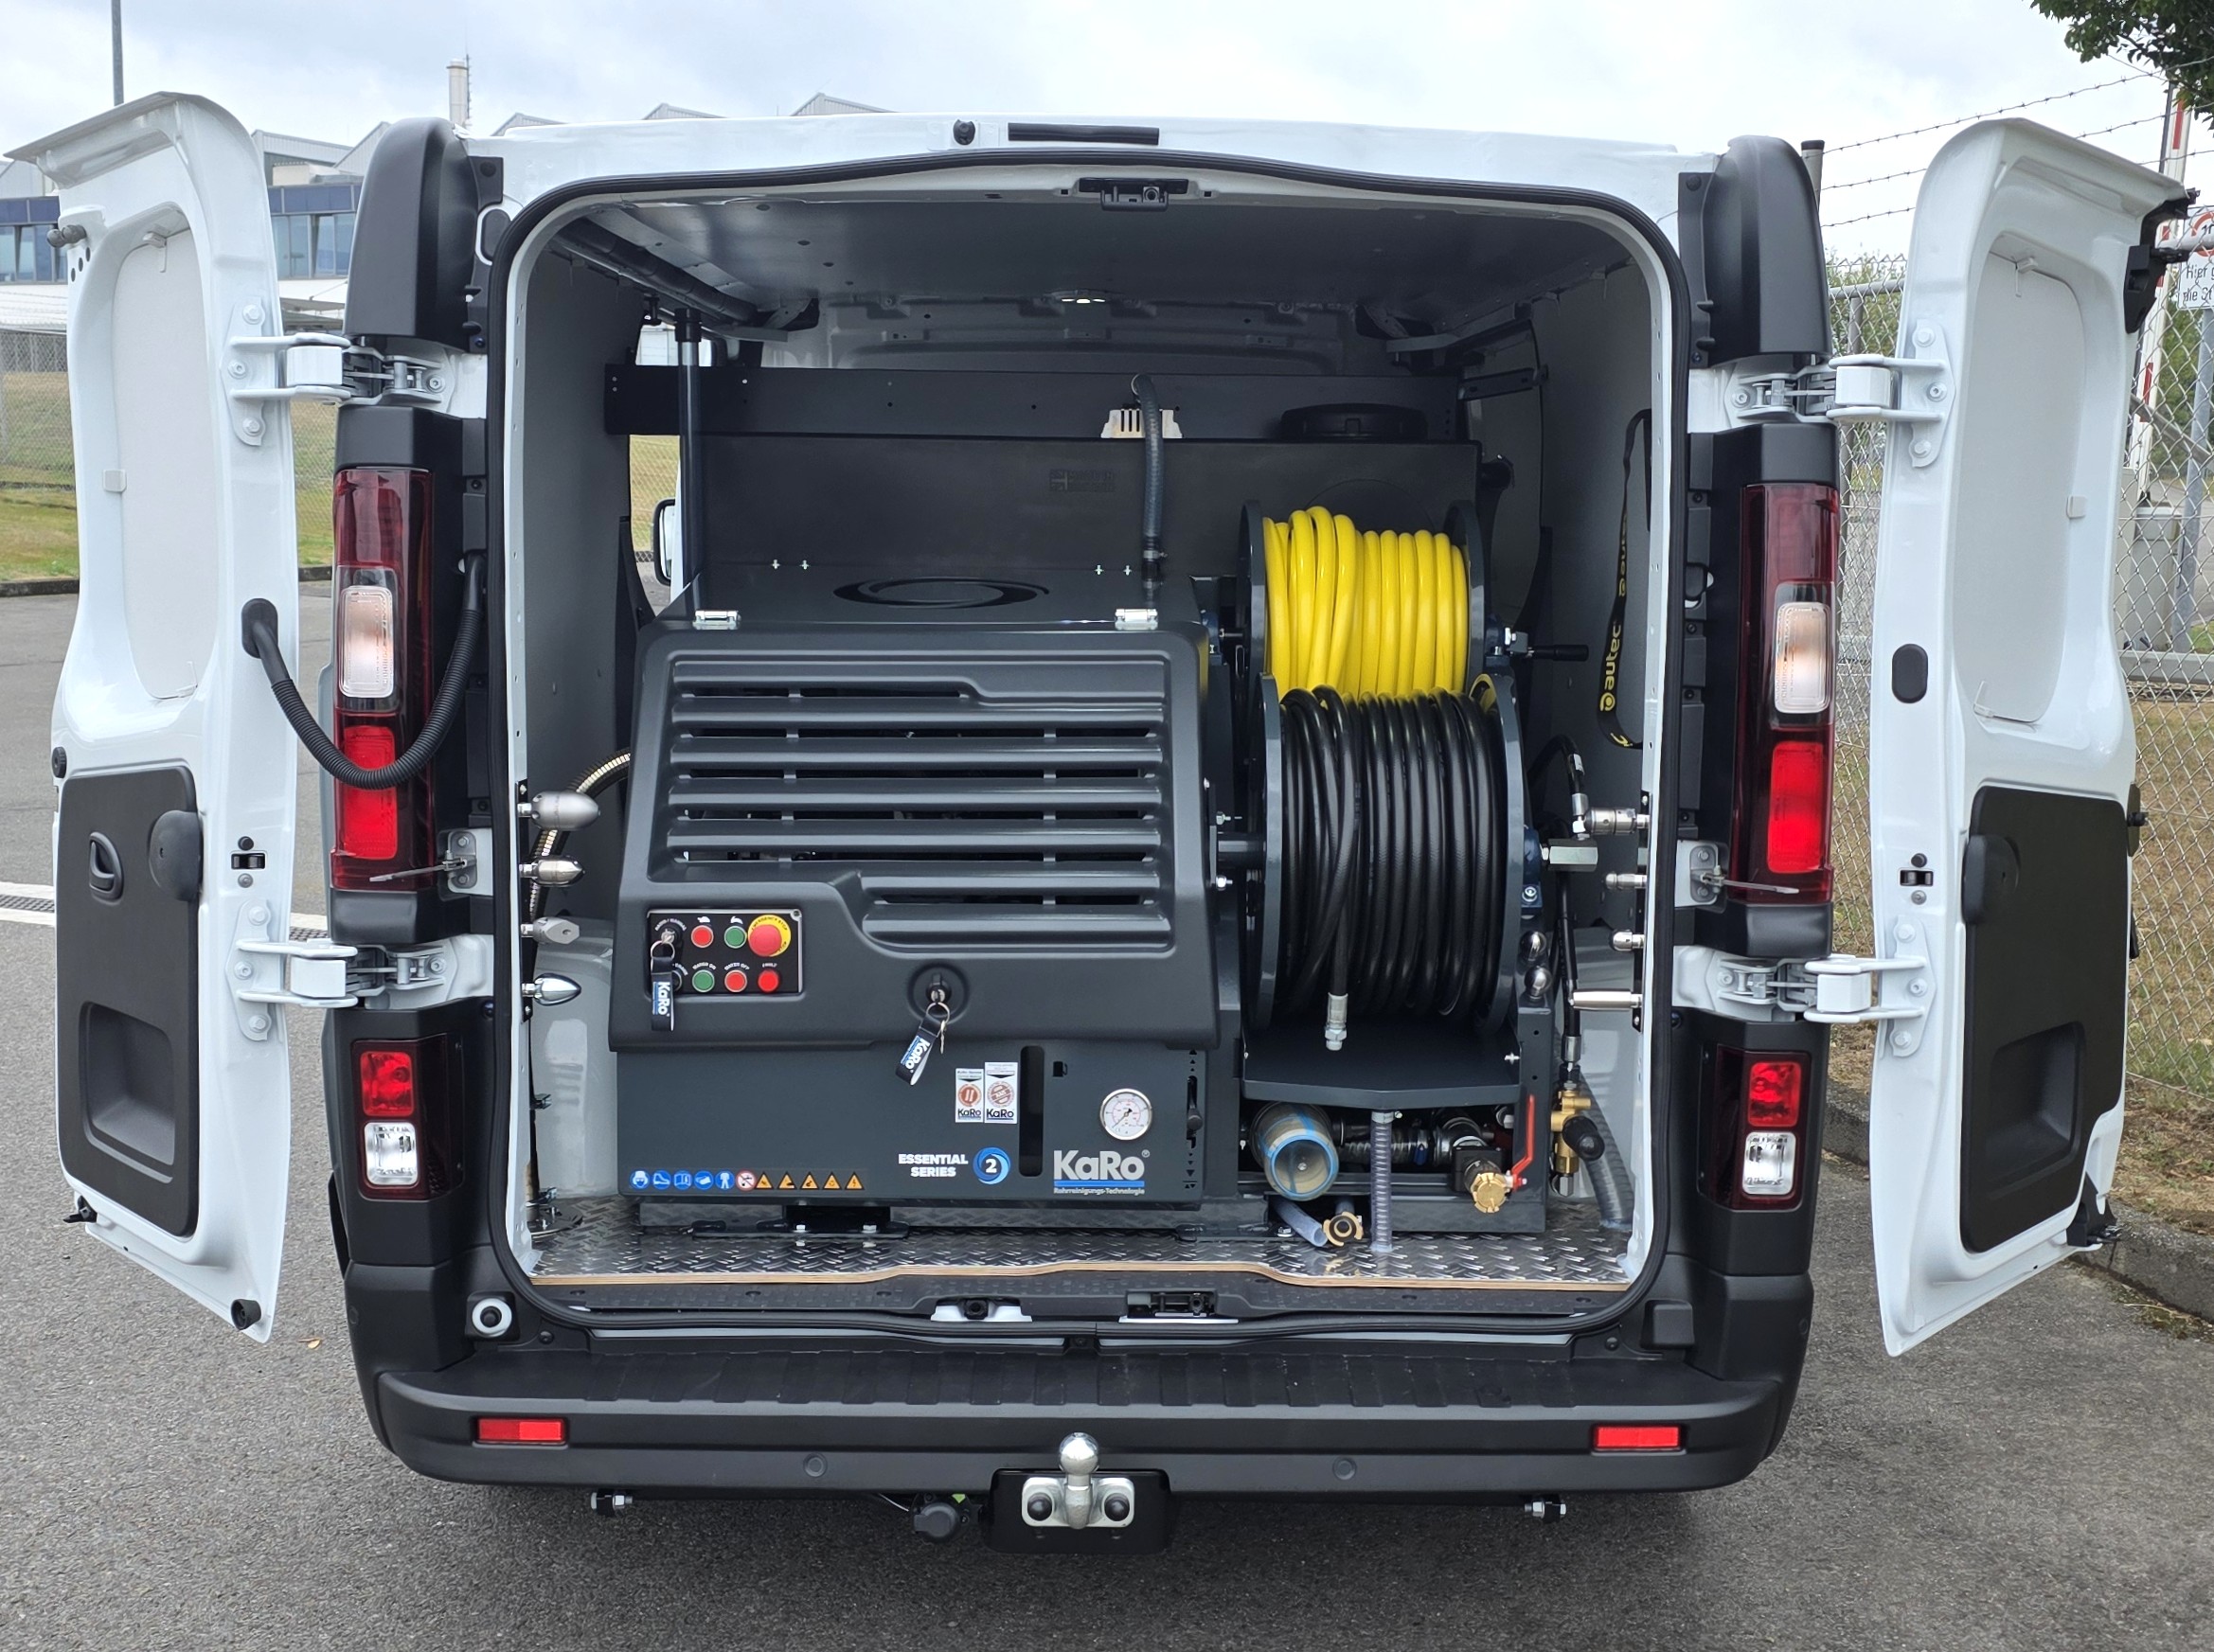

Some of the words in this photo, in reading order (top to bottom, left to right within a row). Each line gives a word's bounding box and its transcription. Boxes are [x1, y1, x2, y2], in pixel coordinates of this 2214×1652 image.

[2187, 265, 2207, 279] Hier
[1605, 624, 1621, 691] autec
[658, 982, 670, 1015] KaRo
[905, 1038, 931, 1070] KaRo
[987, 1109, 1014, 1118] KaRo
[898, 1154, 969, 1164] ESSENTIAL
[985, 1158, 997, 1173] 2
[910, 1166, 956, 1178] SERIES
